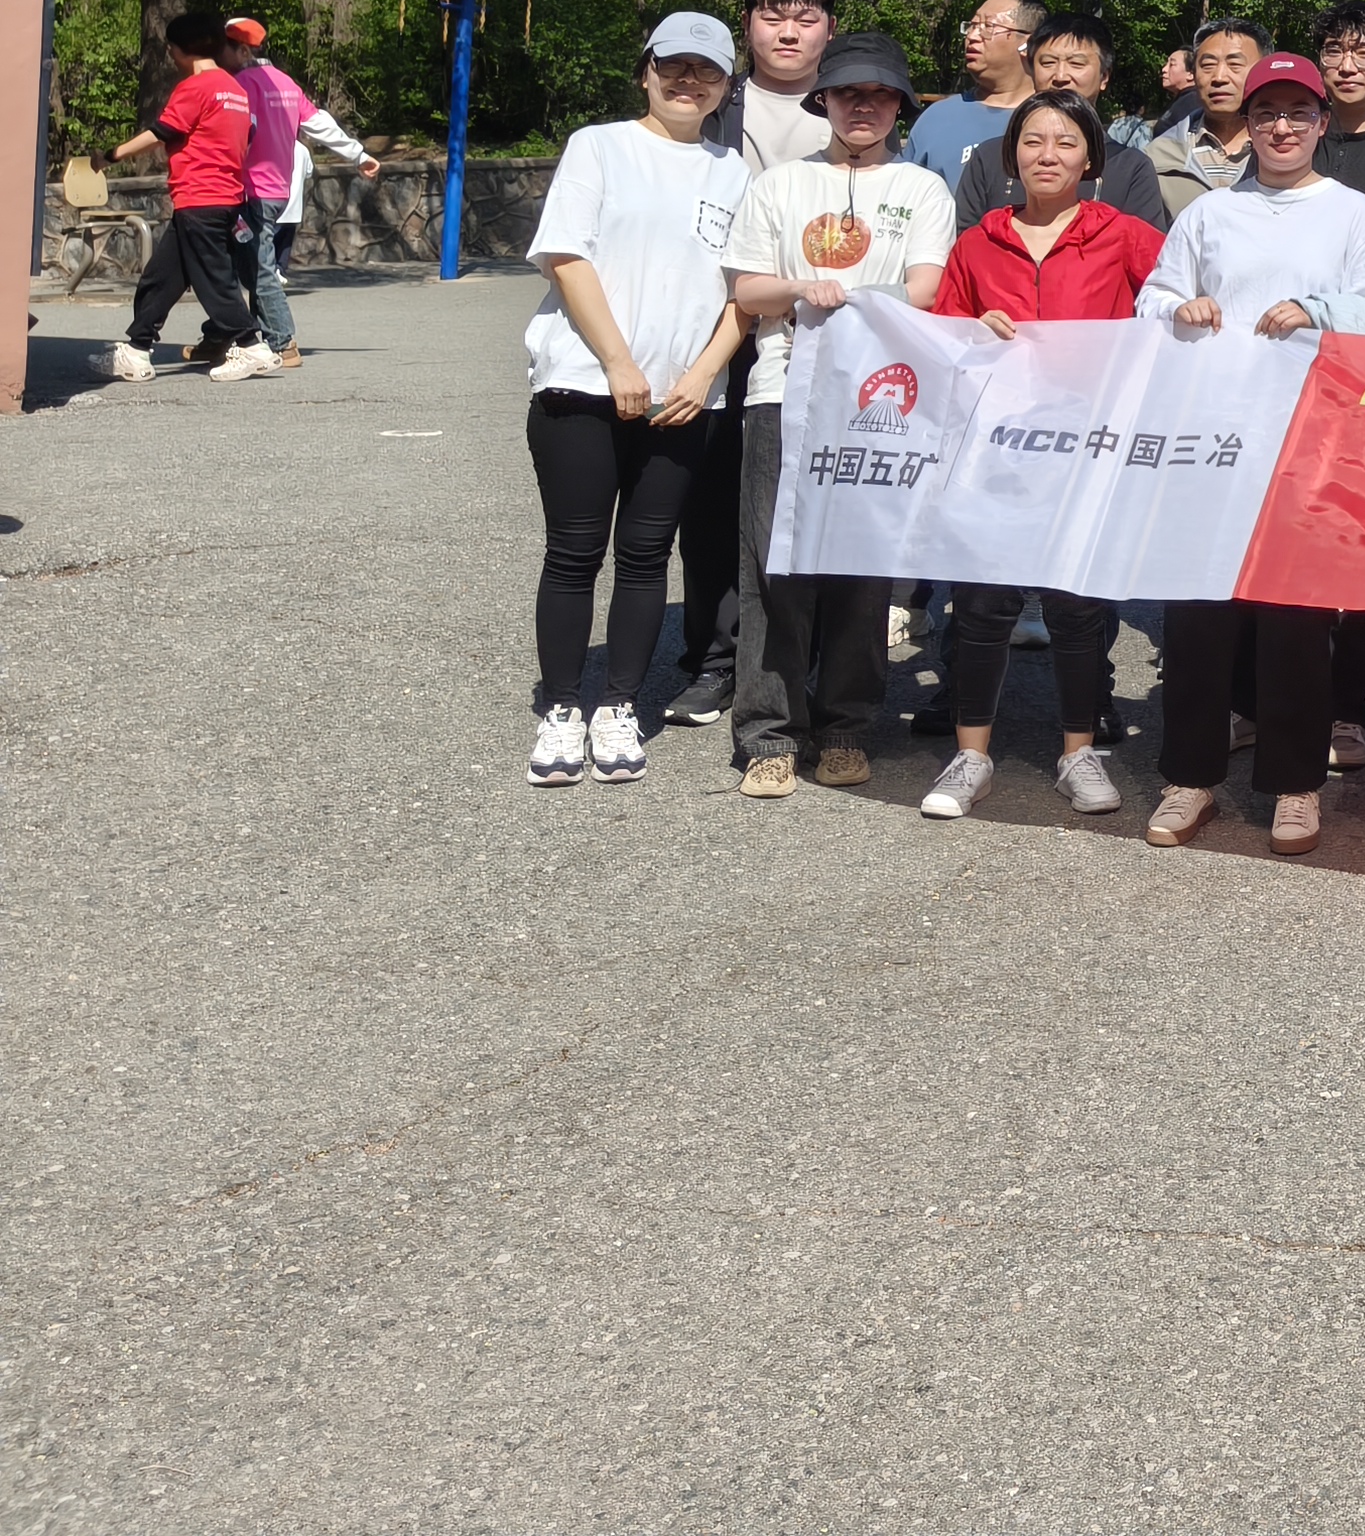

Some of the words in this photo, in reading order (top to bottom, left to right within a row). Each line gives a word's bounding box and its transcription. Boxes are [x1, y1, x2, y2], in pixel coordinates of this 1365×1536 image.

[877, 203, 913, 221] MORE
[880, 217, 904, 229] THAN
[865, 367, 914, 397] MINMETALS
[809, 445, 939, 489] 中国五矿
